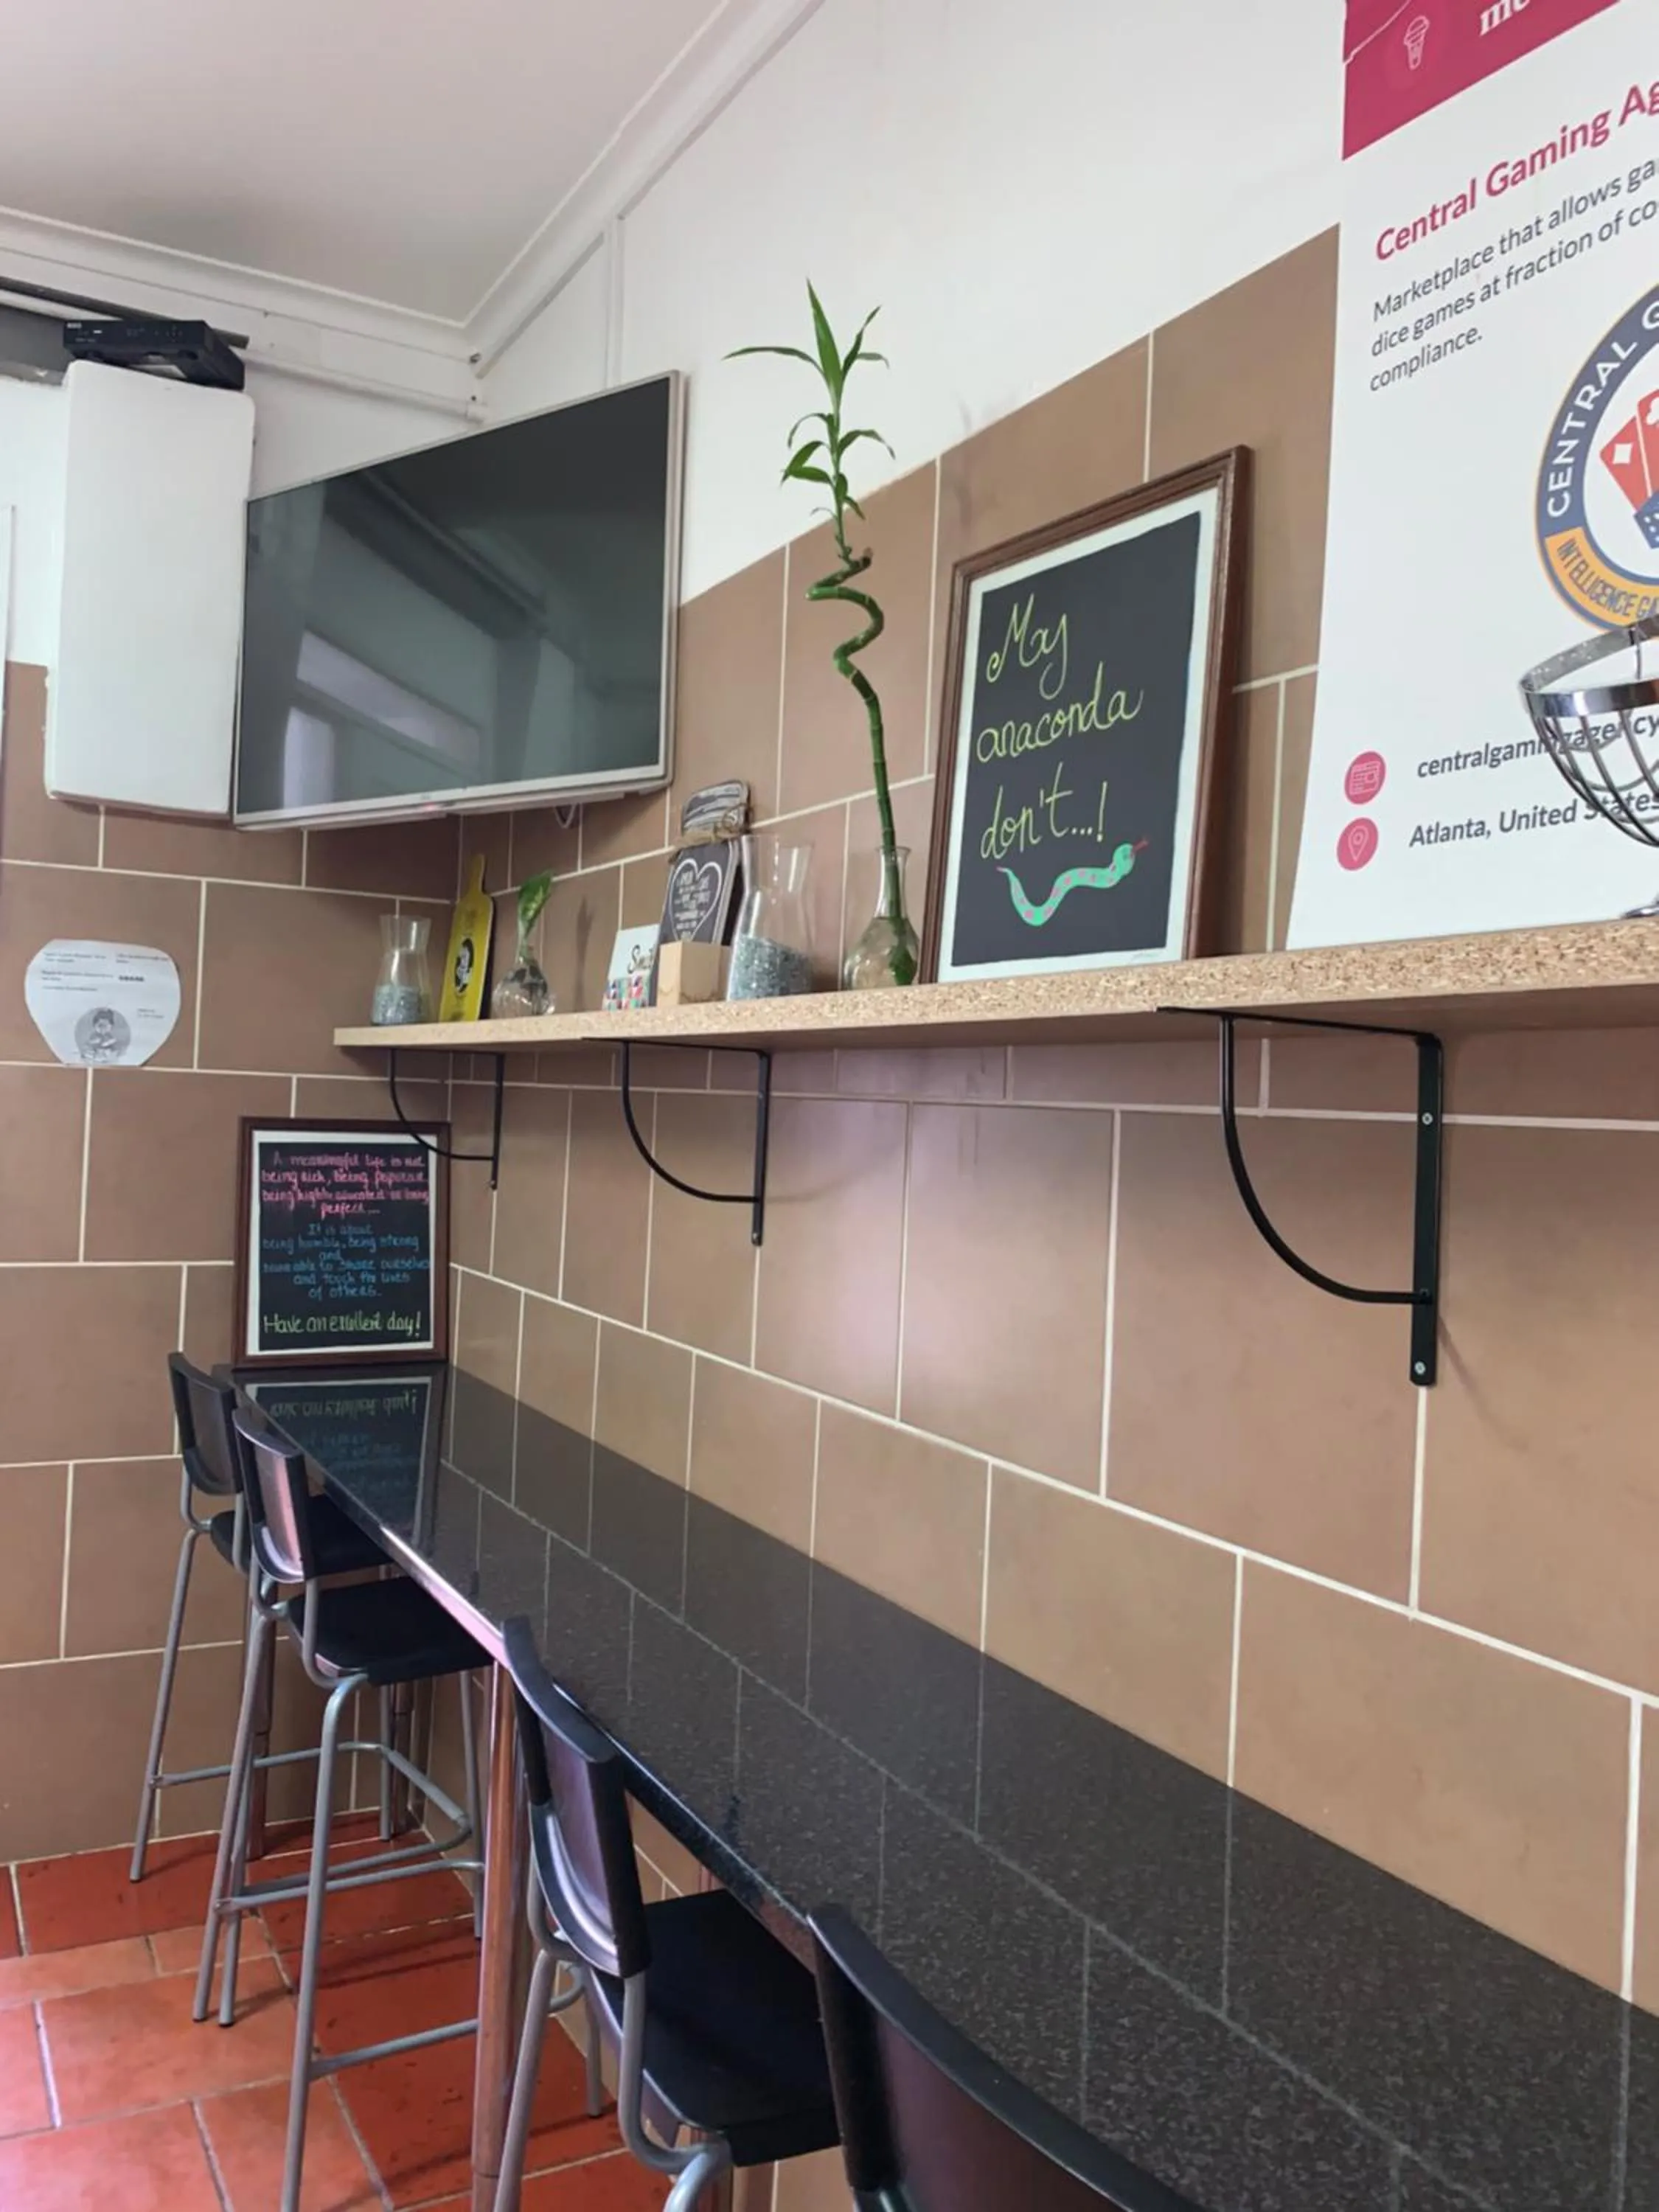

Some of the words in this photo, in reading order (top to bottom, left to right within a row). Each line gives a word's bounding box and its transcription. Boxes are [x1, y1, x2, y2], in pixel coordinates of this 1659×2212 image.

[1377, 177, 1477, 260] Central
[1486, 110, 1612, 198] Gaming
[1371, 326, 1409, 357] dice
[1412, 291, 1475, 341] games
[1480, 276, 1500, 303] at
[1506, 236, 1593, 290] fraction
[1599, 209, 1624, 242] of
[1373, 246, 1494, 322] Marketplace
[1499, 215, 1543, 255] that
[1548, 177, 1621, 230] allows
[1370, 327, 1483, 392] compliance.
[1547, 341, 1638, 517] CENTRAL
[977, 661, 1144, 762] anaconda
[1409, 819, 1491, 847] Atlanta,
[1499, 799, 1578, 833] United
[263, 1312, 304, 1334] Have
[307, 1316, 327, 1332] an
